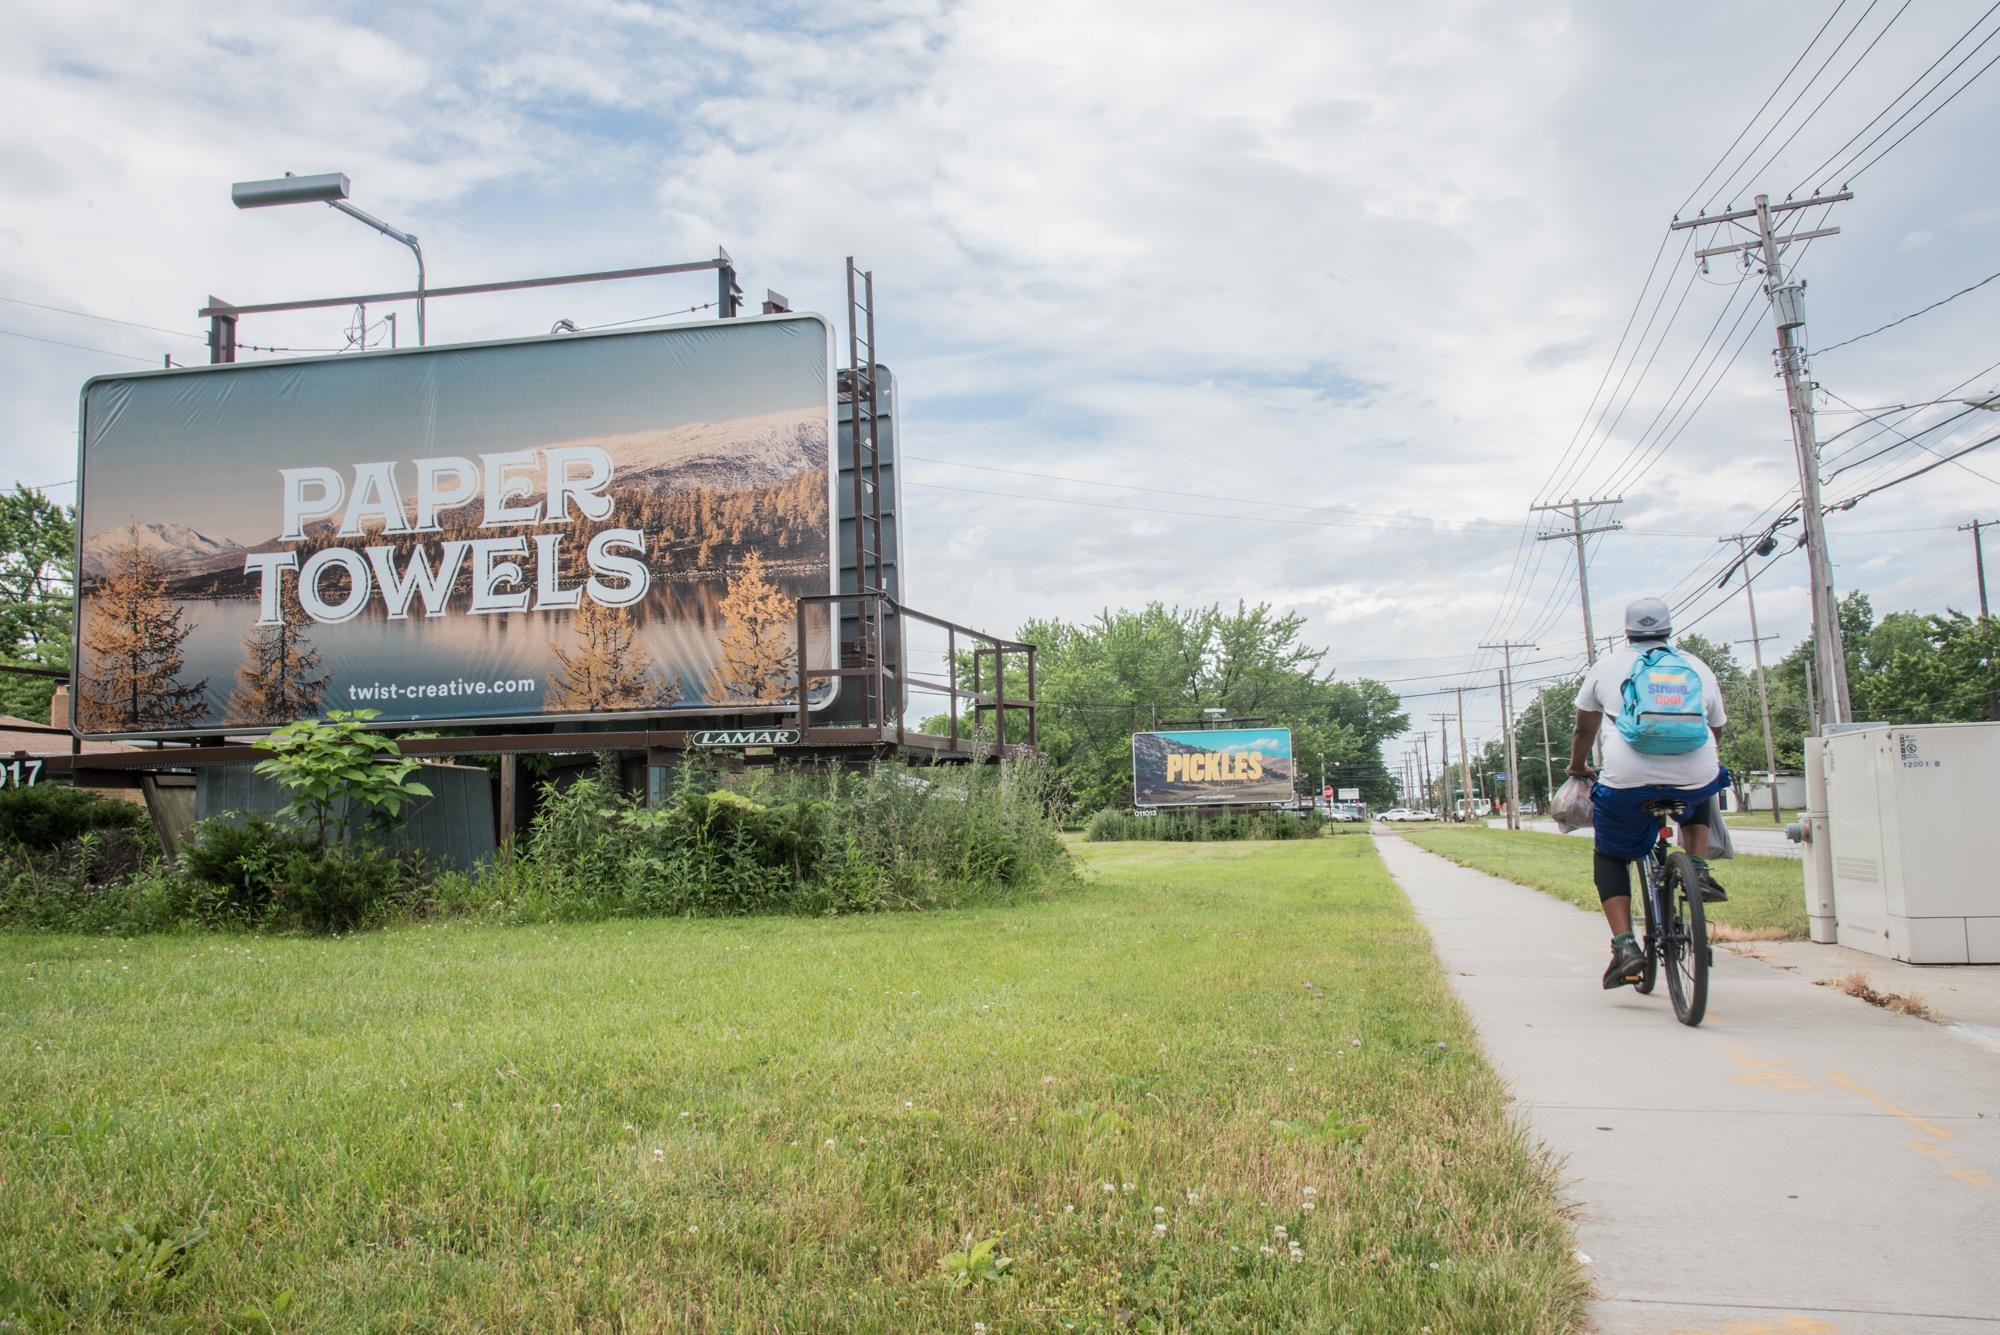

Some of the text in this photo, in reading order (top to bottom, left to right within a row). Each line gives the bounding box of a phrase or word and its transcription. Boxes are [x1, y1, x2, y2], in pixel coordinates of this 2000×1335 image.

[279, 446, 615, 542] PAPER
[243, 529, 651, 627] TOWELS
[349, 678, 535, 700] twist-creative.com
[702, 732, 790, 744] LAMAR
[1166, 751, 1263, 782] PICKLES
[1903, 760, 1929, 768] 12001
